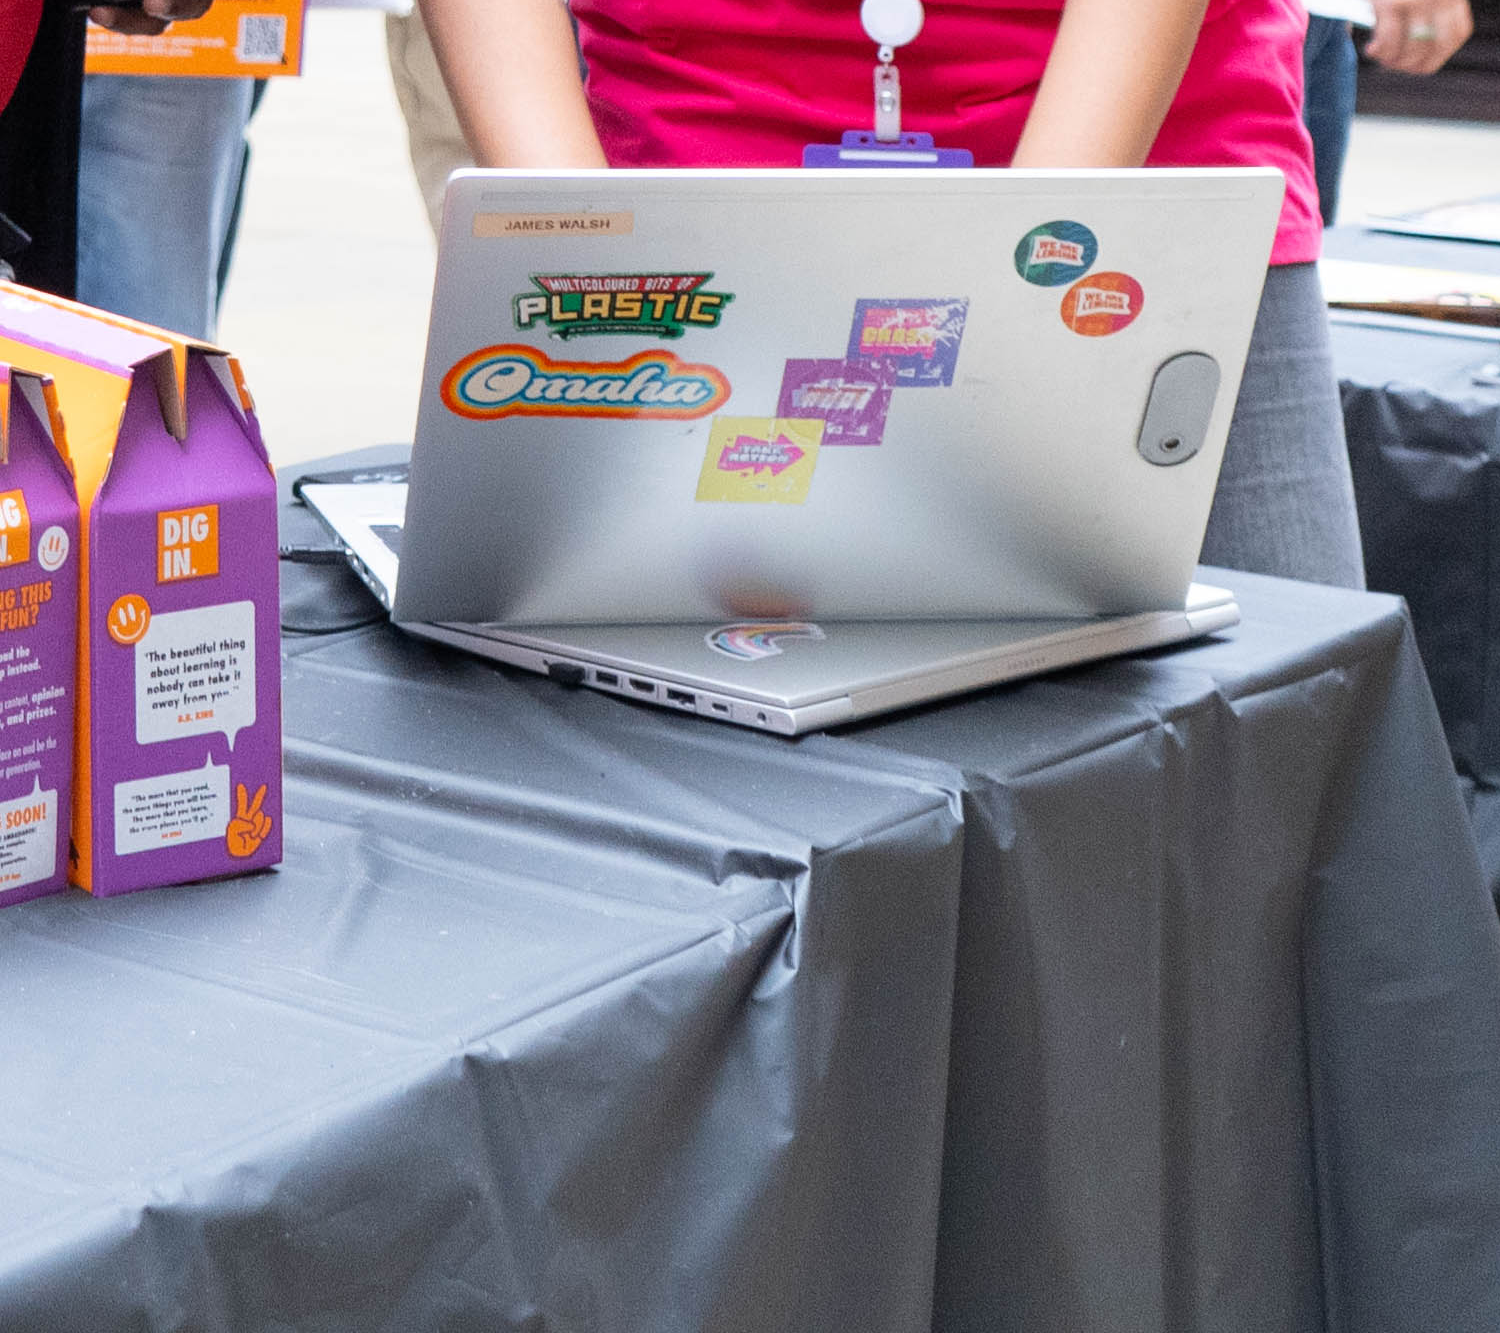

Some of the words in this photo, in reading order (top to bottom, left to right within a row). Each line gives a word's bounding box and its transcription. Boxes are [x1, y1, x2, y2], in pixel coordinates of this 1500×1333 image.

[505, 220, 554, 230] JAMES
[559, 219, 610, 229] WALSH
[549, 277, 639, 291] MULTICOLOURED
[644, 278, 673, 291] BITS
[677, 277, 697, 290] OF
[519, 292, 721, 325] PLASTIC
[464, 359, 709, 405] Omaha
[728, 453, 790, 464] ACTION
[163, 513, 209, 546] DIG
[163, 548, 197, 579] IN.
[21, 582, 52, 606] THIS
[0, 605, 39, 632] FUN?
[16, 644, 30, 659] the
[170, 642, 216, 659] beautiful
[220, 636, 246, 653] thing
[7, 658, 41, 676] instead.
[151, 664, 180, 679] about
[184, 657, 225, 675] learning
[229, 654, 237, 666] is
[32, 684, 64, 704] opinion
[147, 680, 184, 697] nobody
[188, 678, 204, 689] can
[208, 671, 230, 686] take
[234, 669, 240, 681] it
[152, 697, 179, 712] away
[183, 692, 207, 705] from
[7, 710, 24, 725] and
[27, 704, 56, 724] prizes.
[6, 803, 46, 829] SOON!
